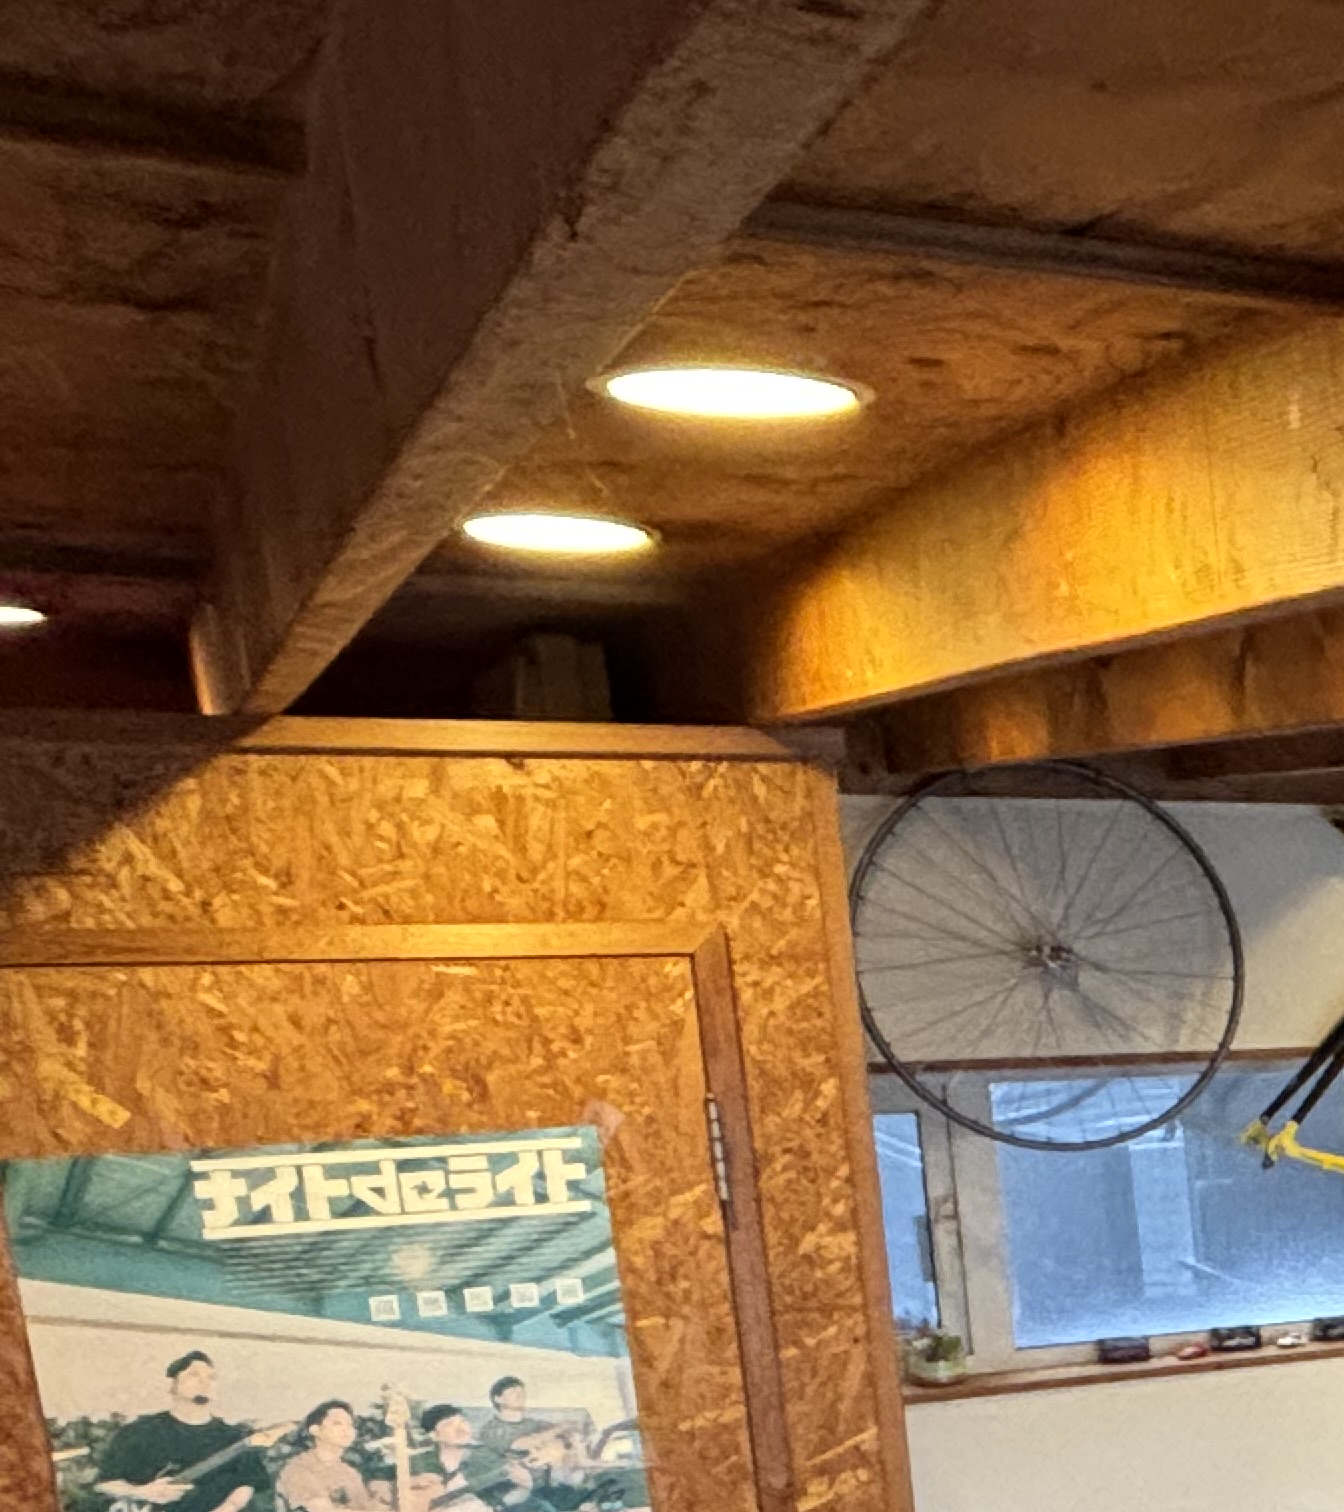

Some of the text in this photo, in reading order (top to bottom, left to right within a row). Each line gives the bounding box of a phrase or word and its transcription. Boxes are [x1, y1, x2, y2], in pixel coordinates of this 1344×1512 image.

[194, 1149, 587, 1229] ナイトdeライト
